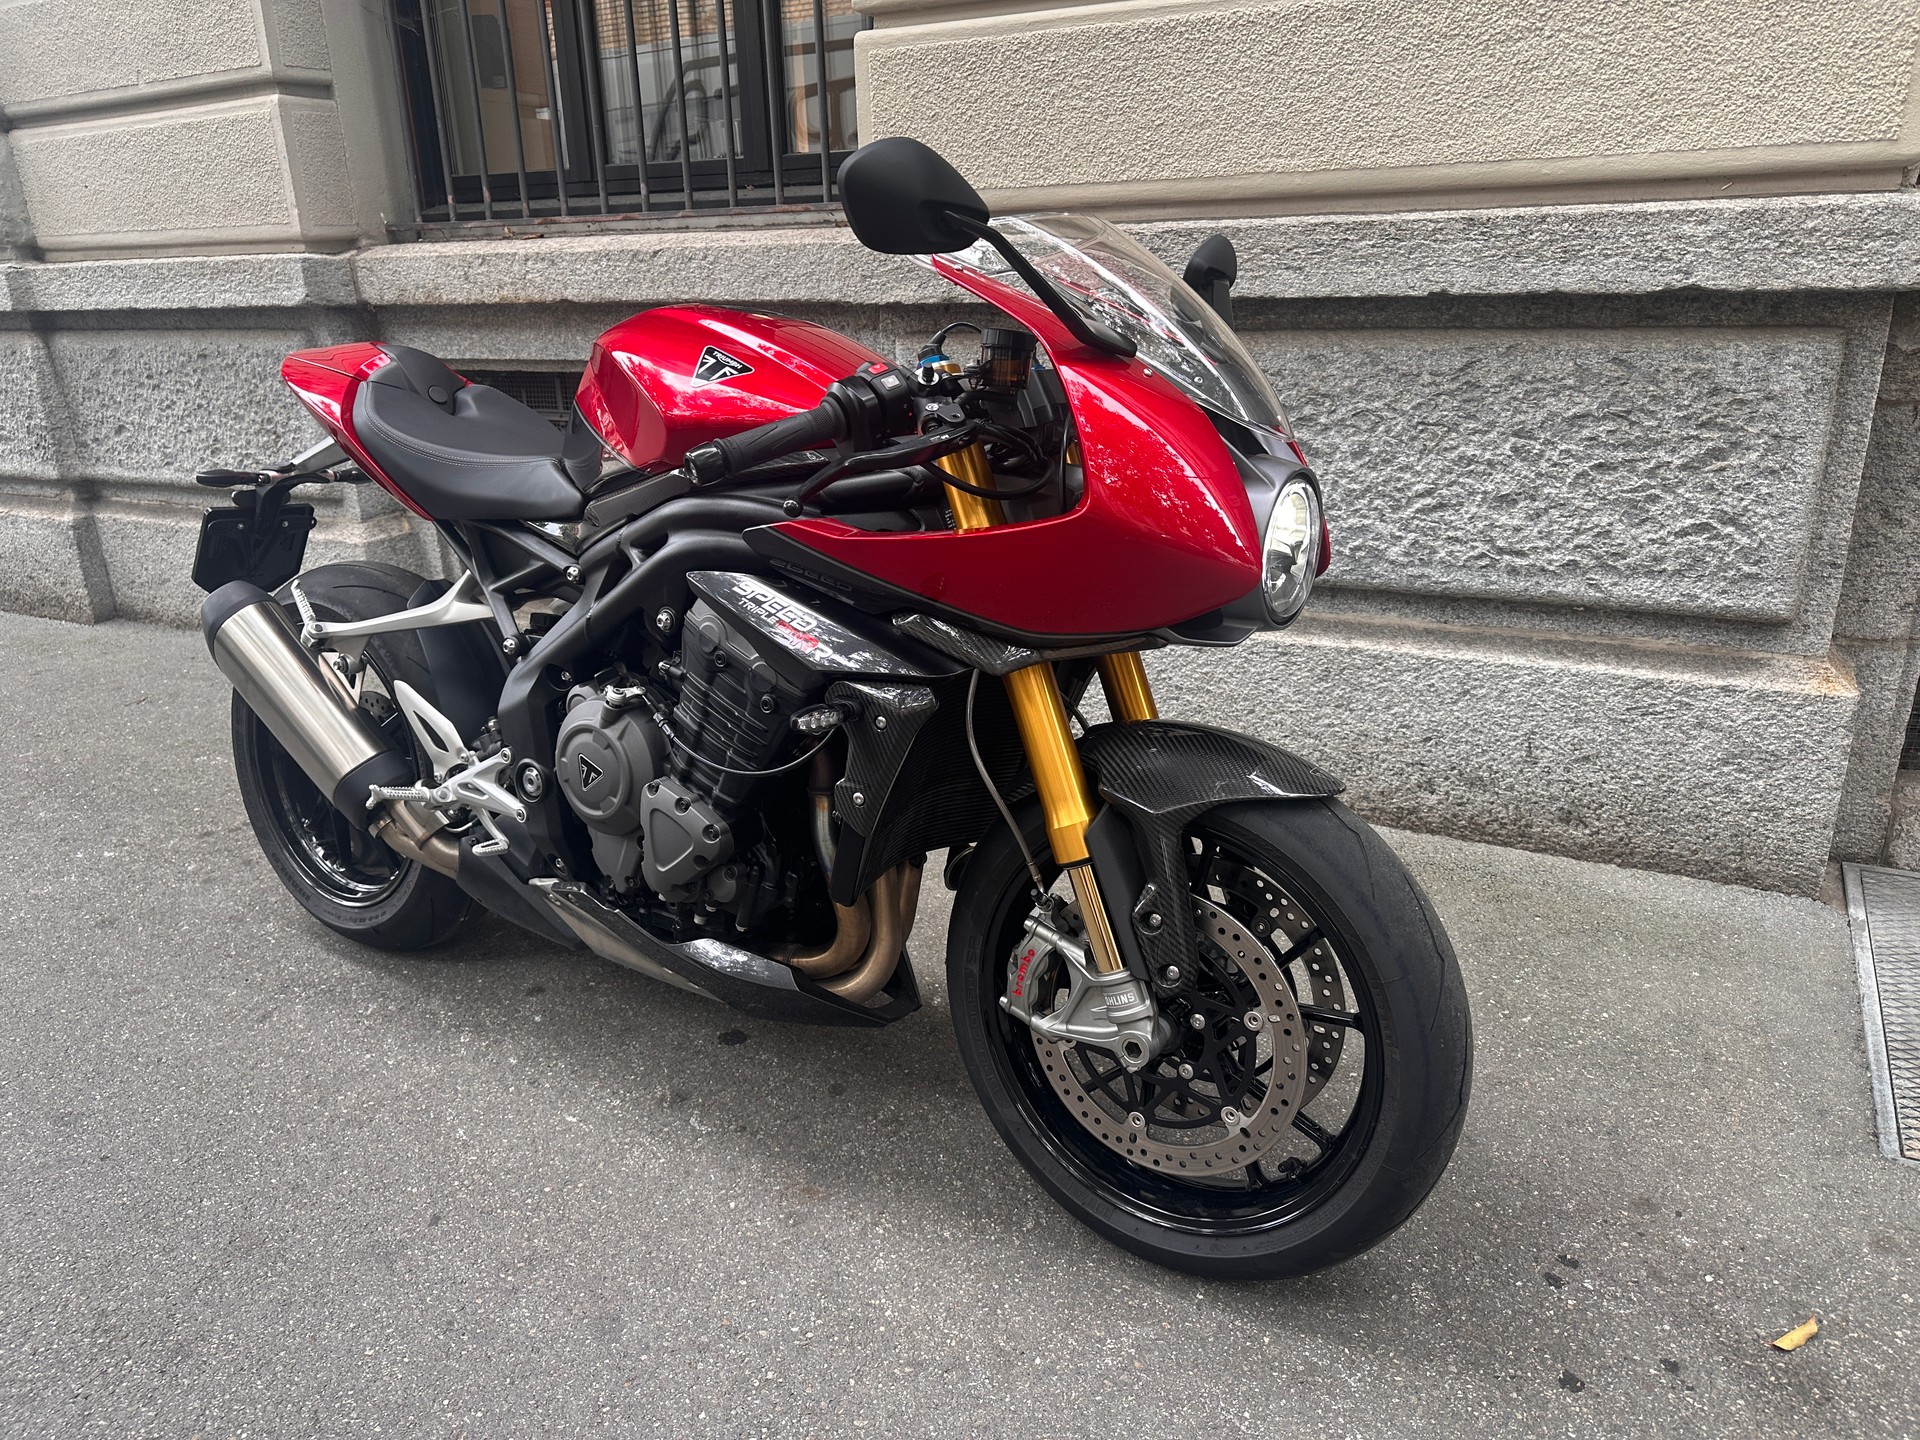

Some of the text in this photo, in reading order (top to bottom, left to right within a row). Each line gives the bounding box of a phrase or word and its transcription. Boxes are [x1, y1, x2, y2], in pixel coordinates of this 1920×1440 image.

[712, 351, 743, 369] TRIUMPH
[732, 579, 818, 632] SPEED
[738, 598, 780, 624] TRIPLE
[1012, 949, 1035, 997] brembo
